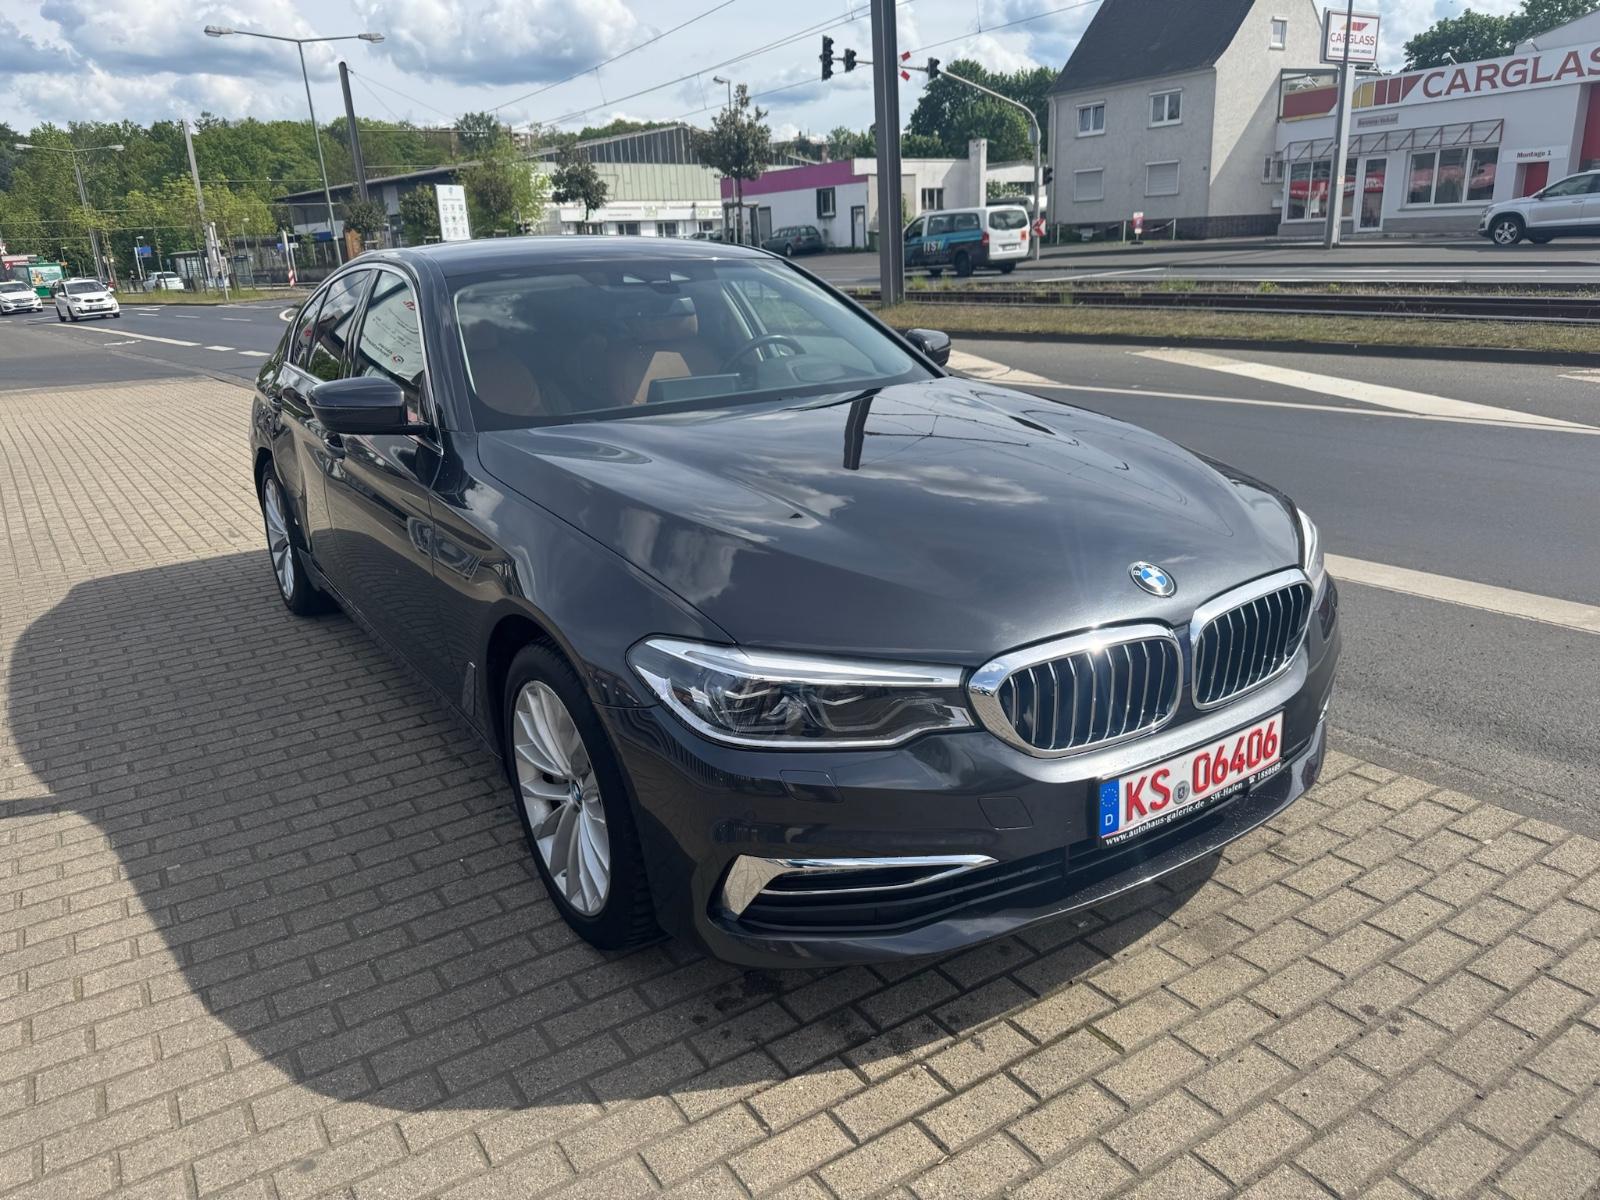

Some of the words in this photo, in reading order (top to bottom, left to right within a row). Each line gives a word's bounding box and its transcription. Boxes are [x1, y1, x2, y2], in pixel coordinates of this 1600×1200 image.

[1126, 768, 1171, 822] KS
[1193, 720, 1278, 794] 06406
[1104, 813, 1114, 827] D
[1105, 800, 1205, 846] www.autohaus-galerie.de
